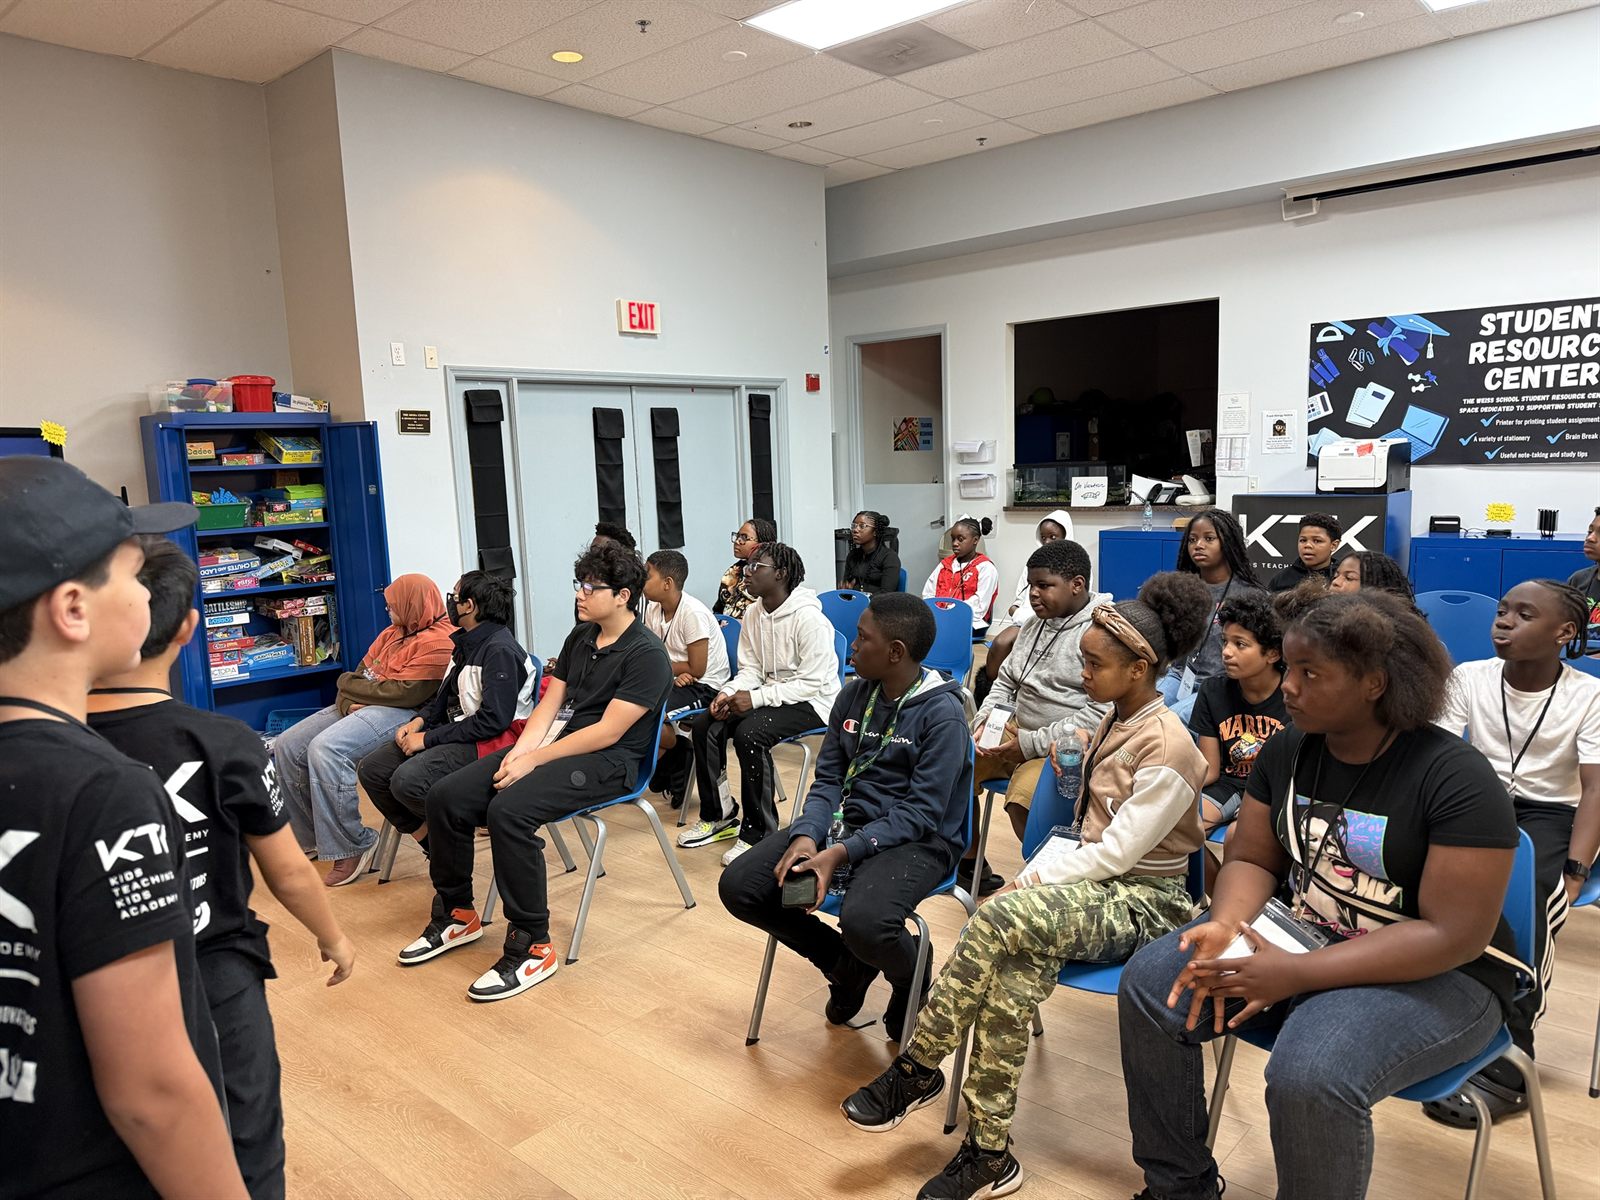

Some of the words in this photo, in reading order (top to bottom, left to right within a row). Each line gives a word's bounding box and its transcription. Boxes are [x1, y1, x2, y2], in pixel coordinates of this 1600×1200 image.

[628, 302, 655, 331] EXIT
[1468, 332, 1600, 365] RESOURC
[1484, 362, 1600, 391] CENTER
[1521, 394, 1550, 402] STUDENT
[1551, 393, 1586, 401] RESOURCE
[1480, 405, 1514, 413] DEDICATED
[1526, 403, 1566, 411] SUPPORTING
[1524, 418, 1545, 427] printing
[1503, 434, 1530, 442] stationery
[1581, 432, 1598, 440] Break
[1500, 451, 1517, 459] Useful
[1518, 451, 1548, 459] note-taking
[1561, 451, 1577, 459] study
[1577, 450, 1588, 458] tips
[1238, 514, 1378, 557] KK
[108, 867, 144, 887] KIDS
[115, 889, 152, 909] KIDS
